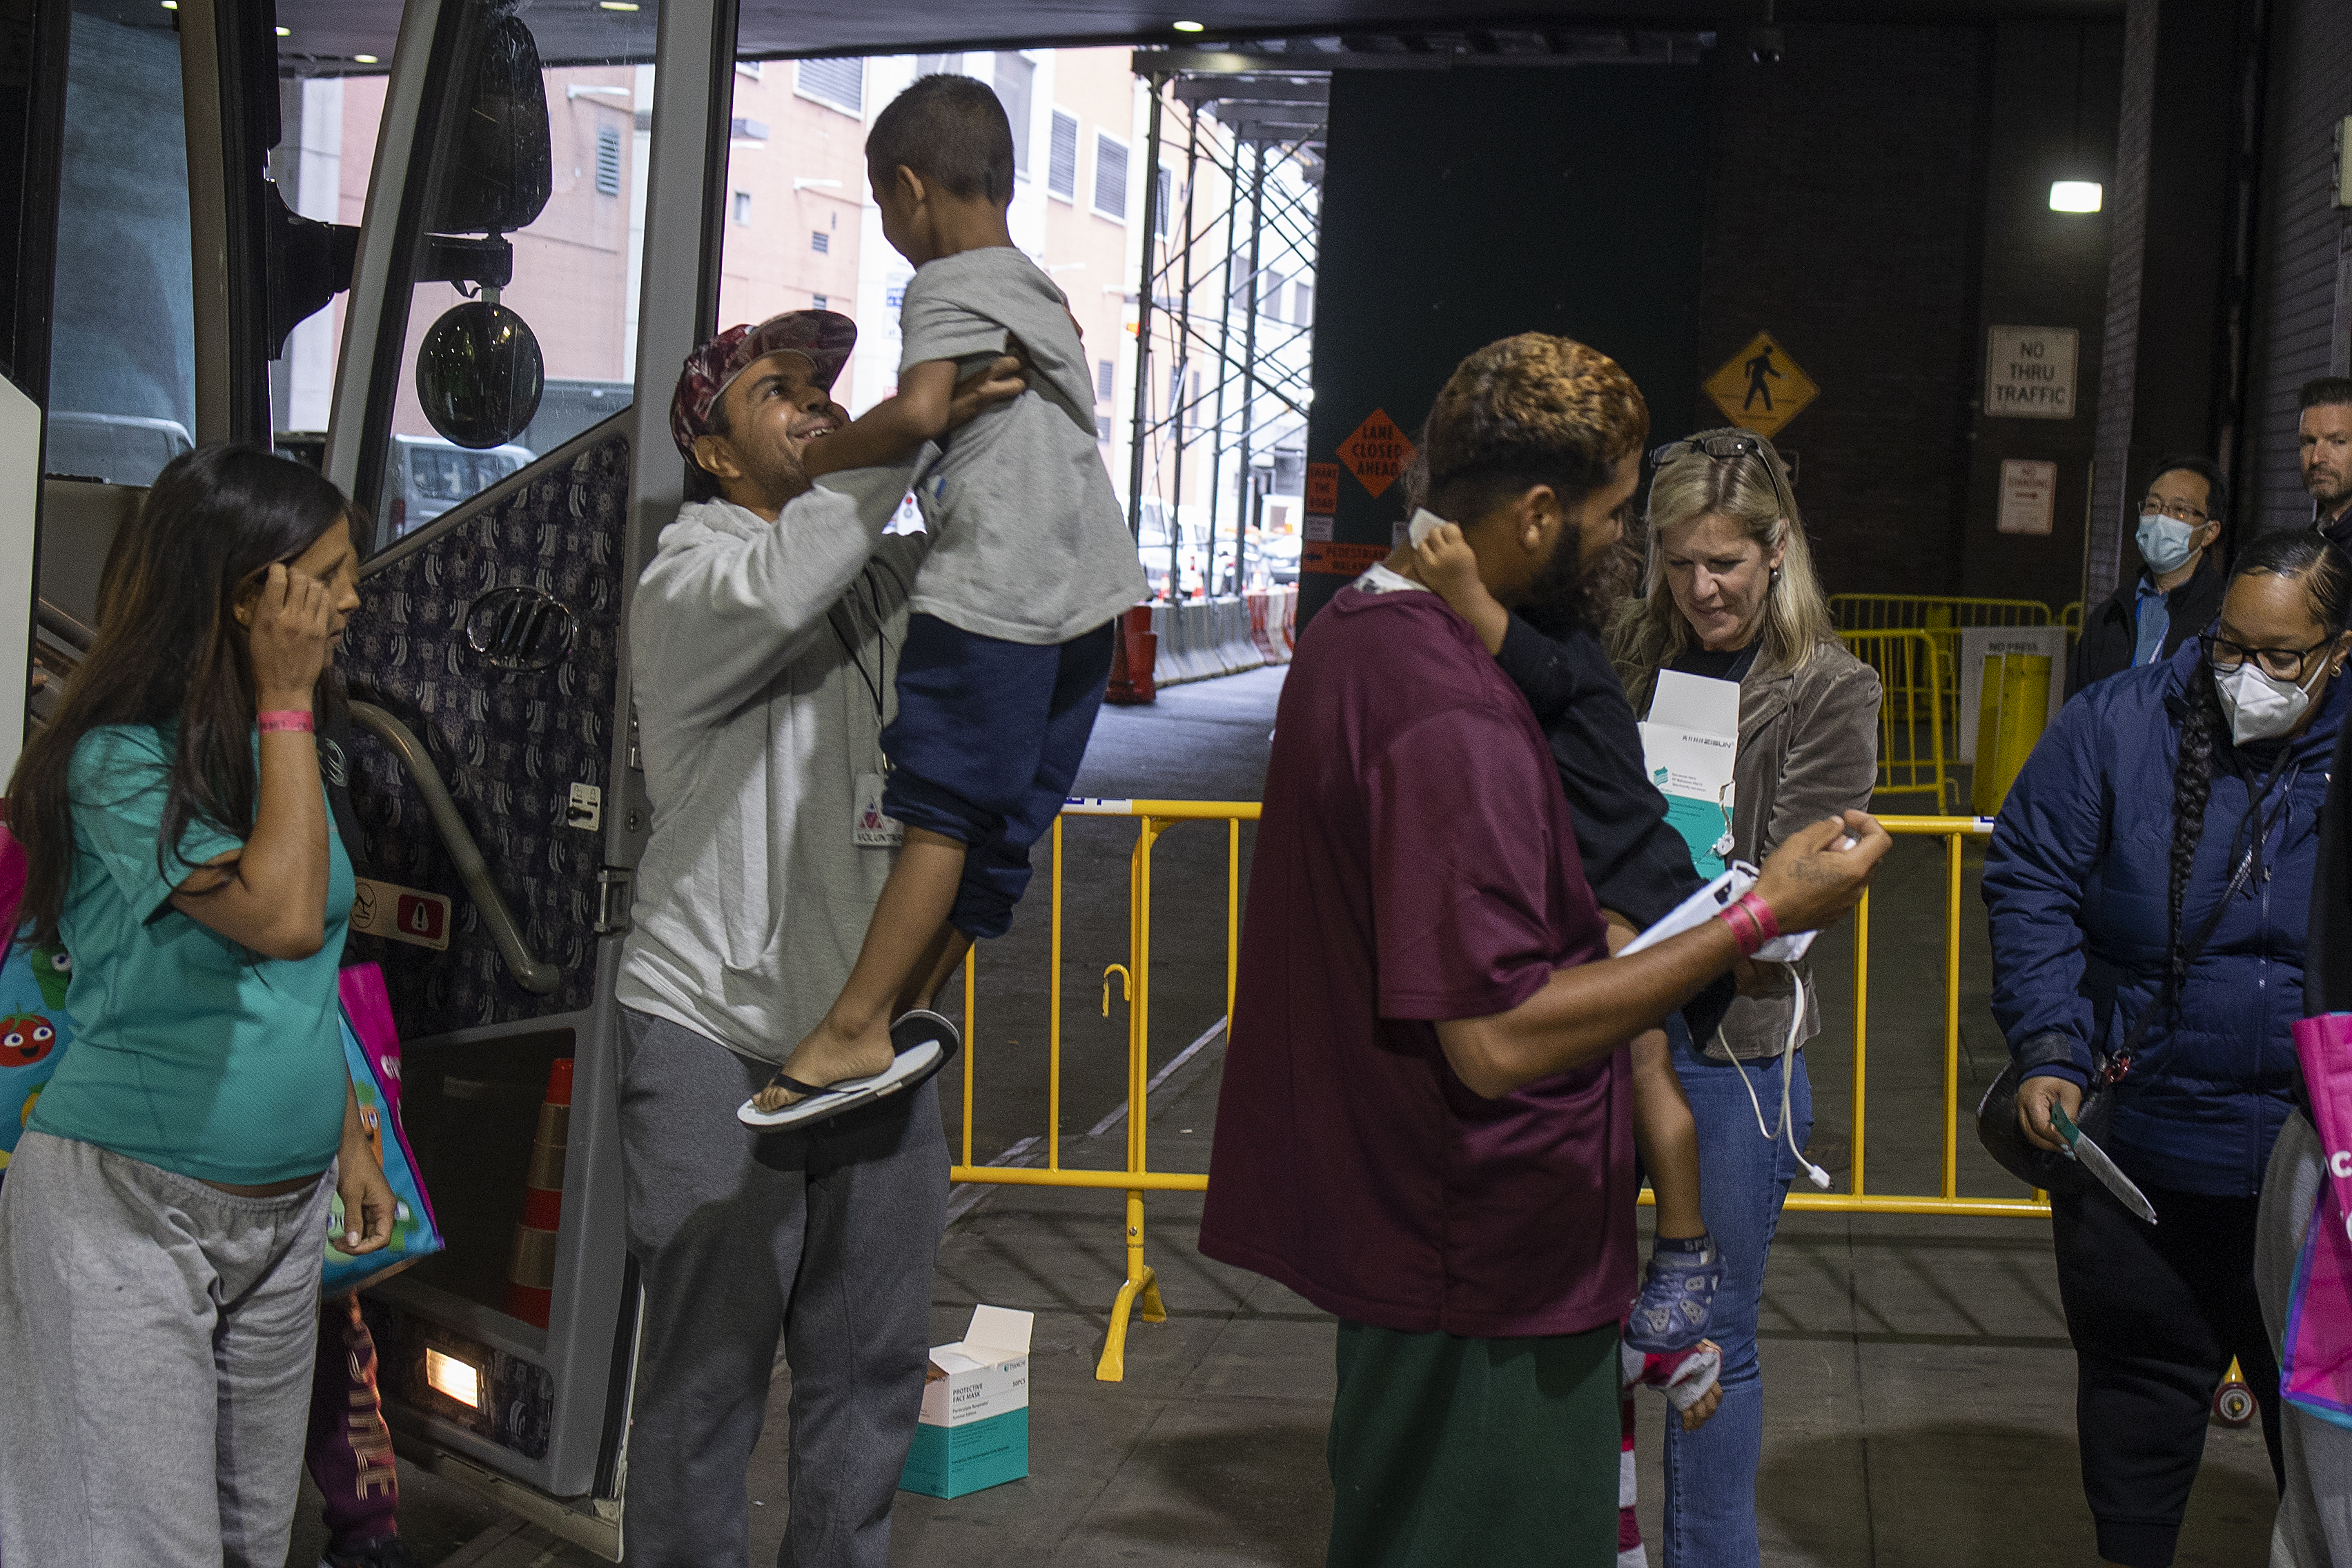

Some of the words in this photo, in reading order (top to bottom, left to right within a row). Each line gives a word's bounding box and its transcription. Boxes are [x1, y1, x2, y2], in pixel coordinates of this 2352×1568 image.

[2019, 341, 2045, 358] NO
[2010, 364, 2055, 381] THRU
[1995, 384, 2066, 404] TRAFFIC
[1362, 425, 1393, 440] LANE
[1351, 443, 1403, 460] CLOSED
[1357, 461, 1399, 477] AHEAD
[953, 1383, 983, 1395] PROTECTIVE
[952, 1395, 966, 1404] FACE
[966, 1391, 981, 1400] MASK
